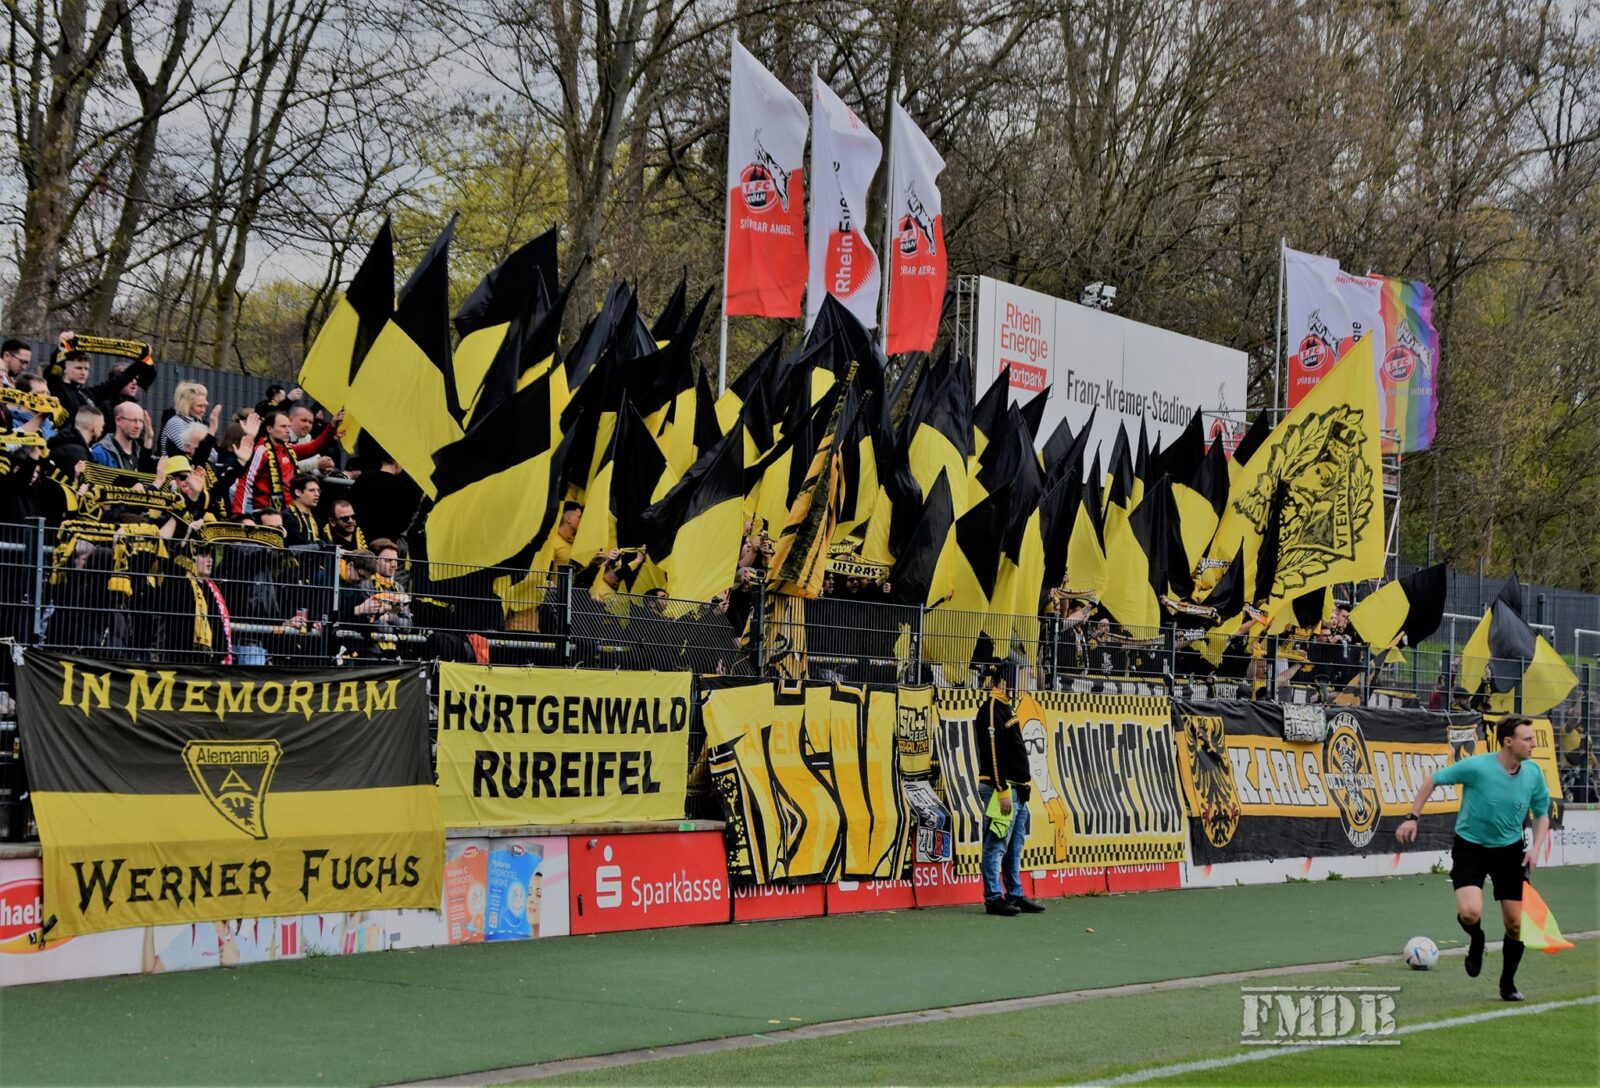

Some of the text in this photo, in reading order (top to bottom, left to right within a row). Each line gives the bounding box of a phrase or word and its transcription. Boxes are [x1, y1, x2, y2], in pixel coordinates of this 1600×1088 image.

[1000, 323, 1049, 362] Energie
[1006, 303, 1041, 336] Rhein
[1067, 369, 1193, 428] Franz-Kremer-Stadion
[125, 668, 401, 723] MEMORIAM
[442, 684, 688, 735] HÜRTGENWALD
[195, 745, 270, 765] Alemannia
[473, 750, 661, 799] RUREIFEL
[1227, 746, 1329, 806] KARLS
[70, 849, 421, 915] WERNER FUCHS
[631, 871, 721, 914] Sparkasse
